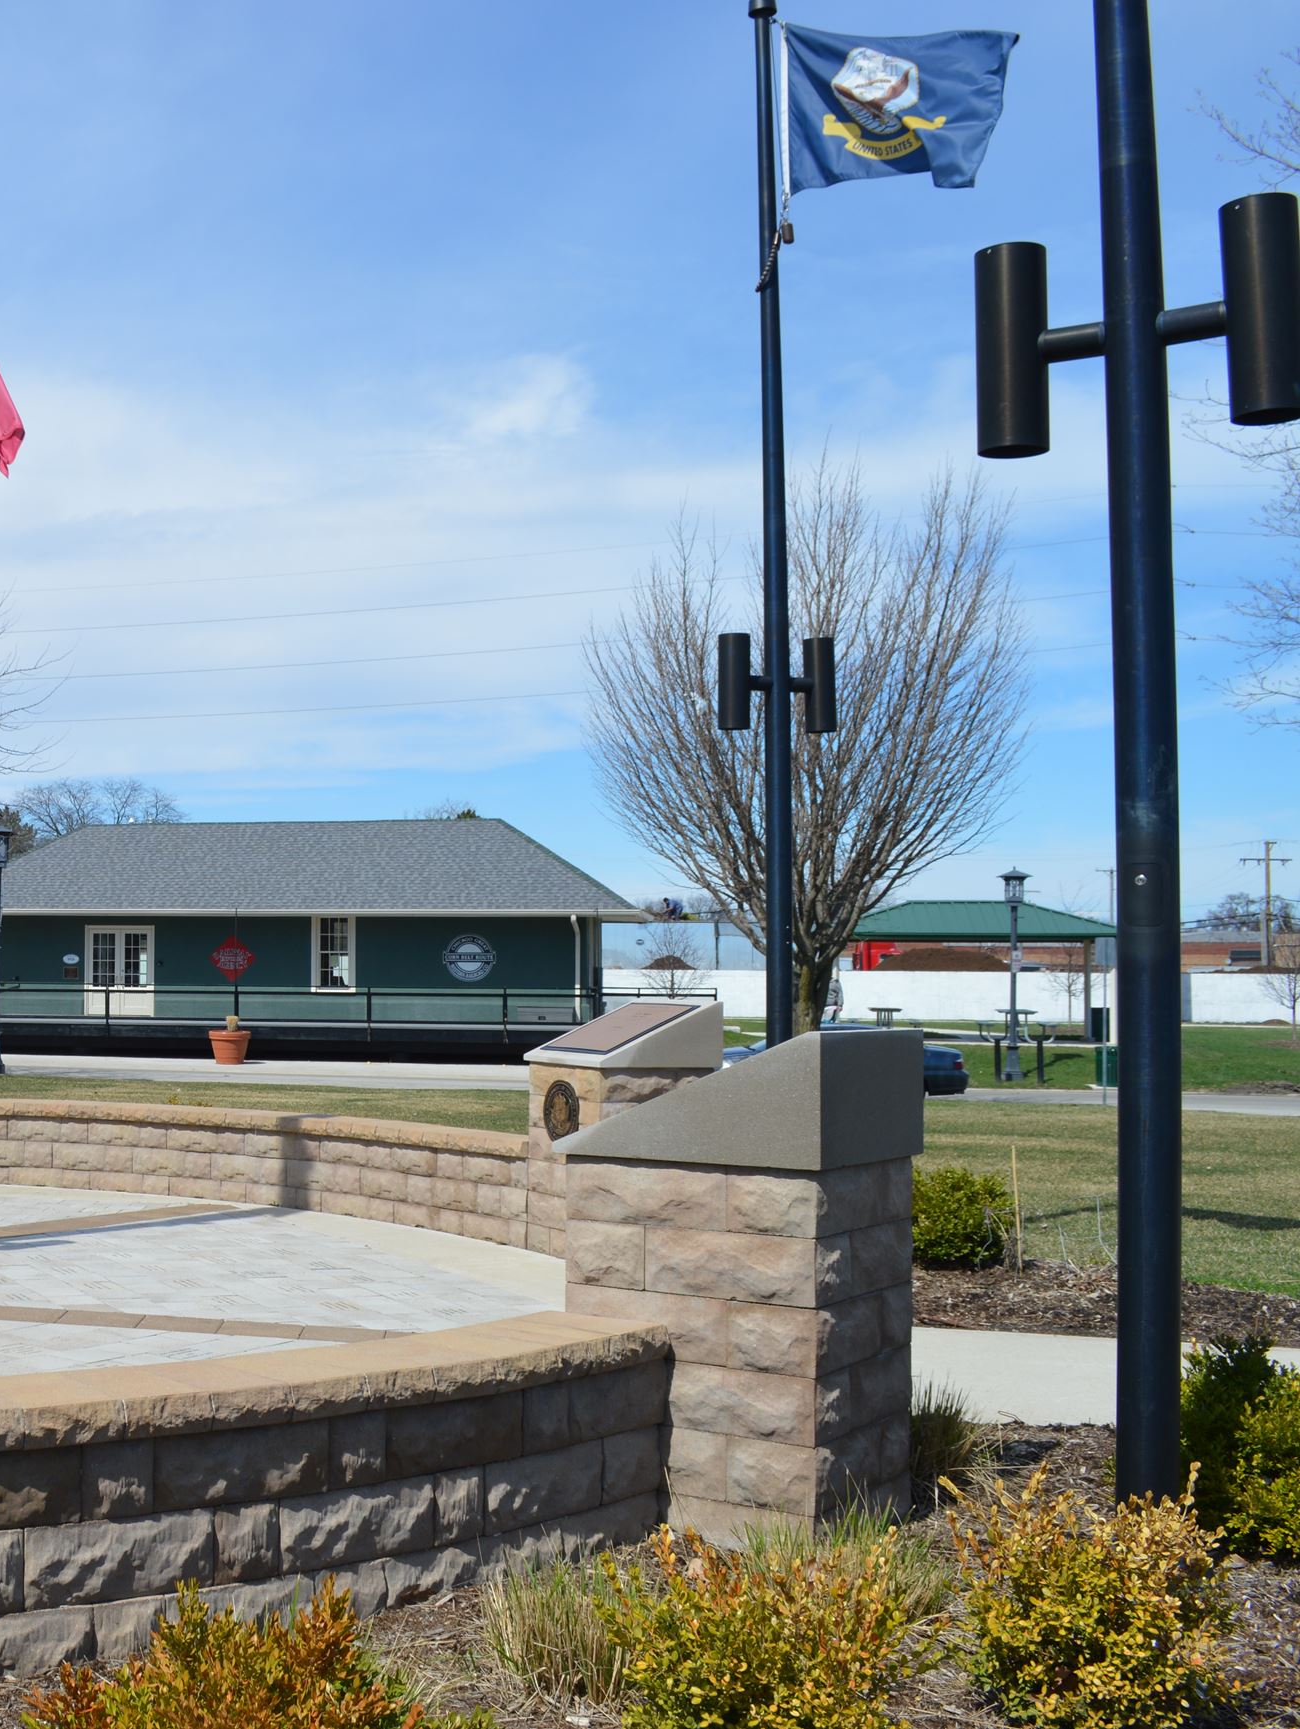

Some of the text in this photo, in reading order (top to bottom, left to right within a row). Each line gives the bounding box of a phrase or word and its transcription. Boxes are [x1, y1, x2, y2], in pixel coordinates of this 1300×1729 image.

[852, 138, 913, 157] UNITED STATES
[451, 937, 489, 951] CHICAGO GREAT
